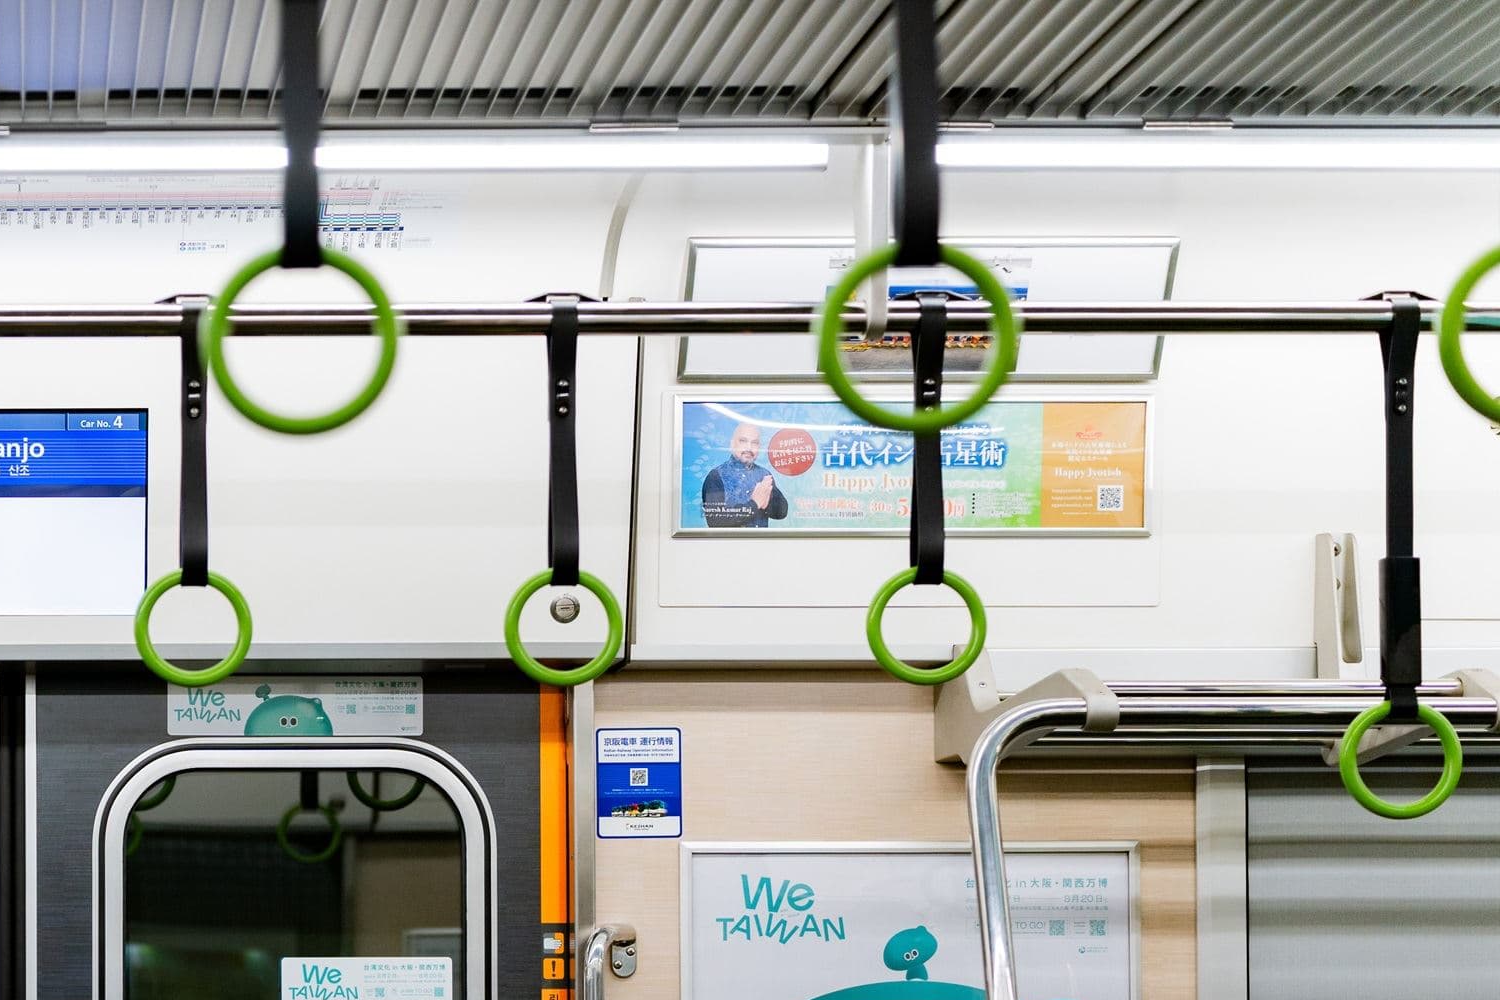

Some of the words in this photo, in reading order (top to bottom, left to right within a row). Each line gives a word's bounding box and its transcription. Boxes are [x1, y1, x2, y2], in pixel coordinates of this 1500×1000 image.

[80, 420, 95, 428] Car
[96, 420, 111, 428] No.
[113, 415, 123, 429] 4
[824, 439, 1005, 467] 古代イン占星術
[8, 465, 31, 477] 산조
[1054, 466, 1085, 480] Happy
[1087, 466, 1122, 480] Jyotish
[823, 473, 876, 491] Happy
[882, 473, 914, 492] Jyot
[187, 687, 225, 707] We
[174, 704, 241, 724] TAIWAN
[603, 737, 637, 746] 京阪電車
[640, 737, 674, 746] 運行情報
[741, 873, 815, 913] We
[1015, 879, 1027, 889] in
[1030, 878, 1108, 889] 大阪・関西万博
[715, 912, 846, 945] TAIWAN
[1015, 921, 1027, 930] TO
[302, 964, 341, 985] We
